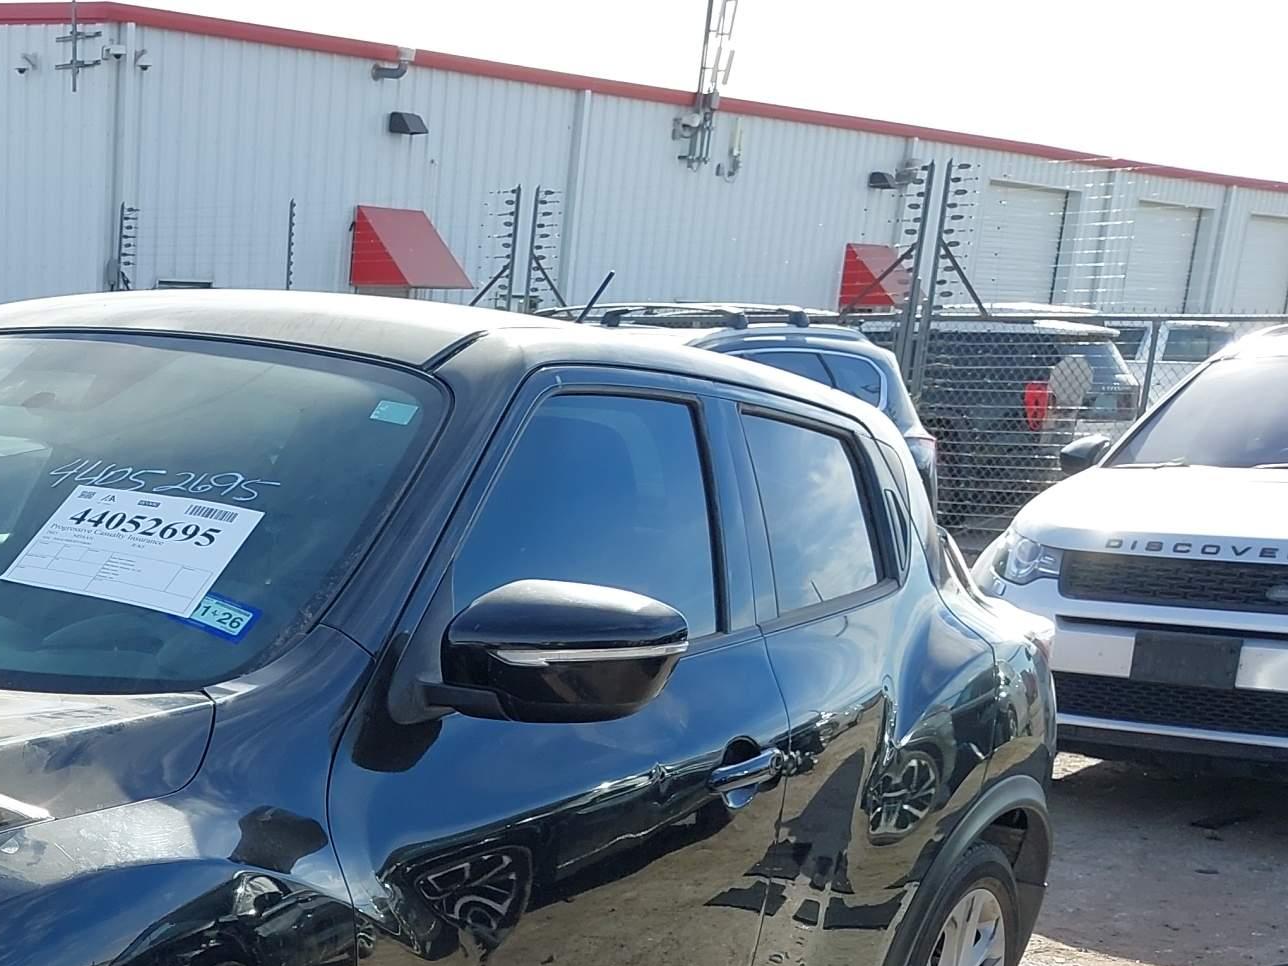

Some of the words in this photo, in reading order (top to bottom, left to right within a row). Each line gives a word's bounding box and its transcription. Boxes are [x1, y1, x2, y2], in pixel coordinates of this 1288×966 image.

[69, 507, 223, 547] 44052695
[127, 534, 164, 546] Insurance
[1105, 539, 1288, 559] DISCOVE
